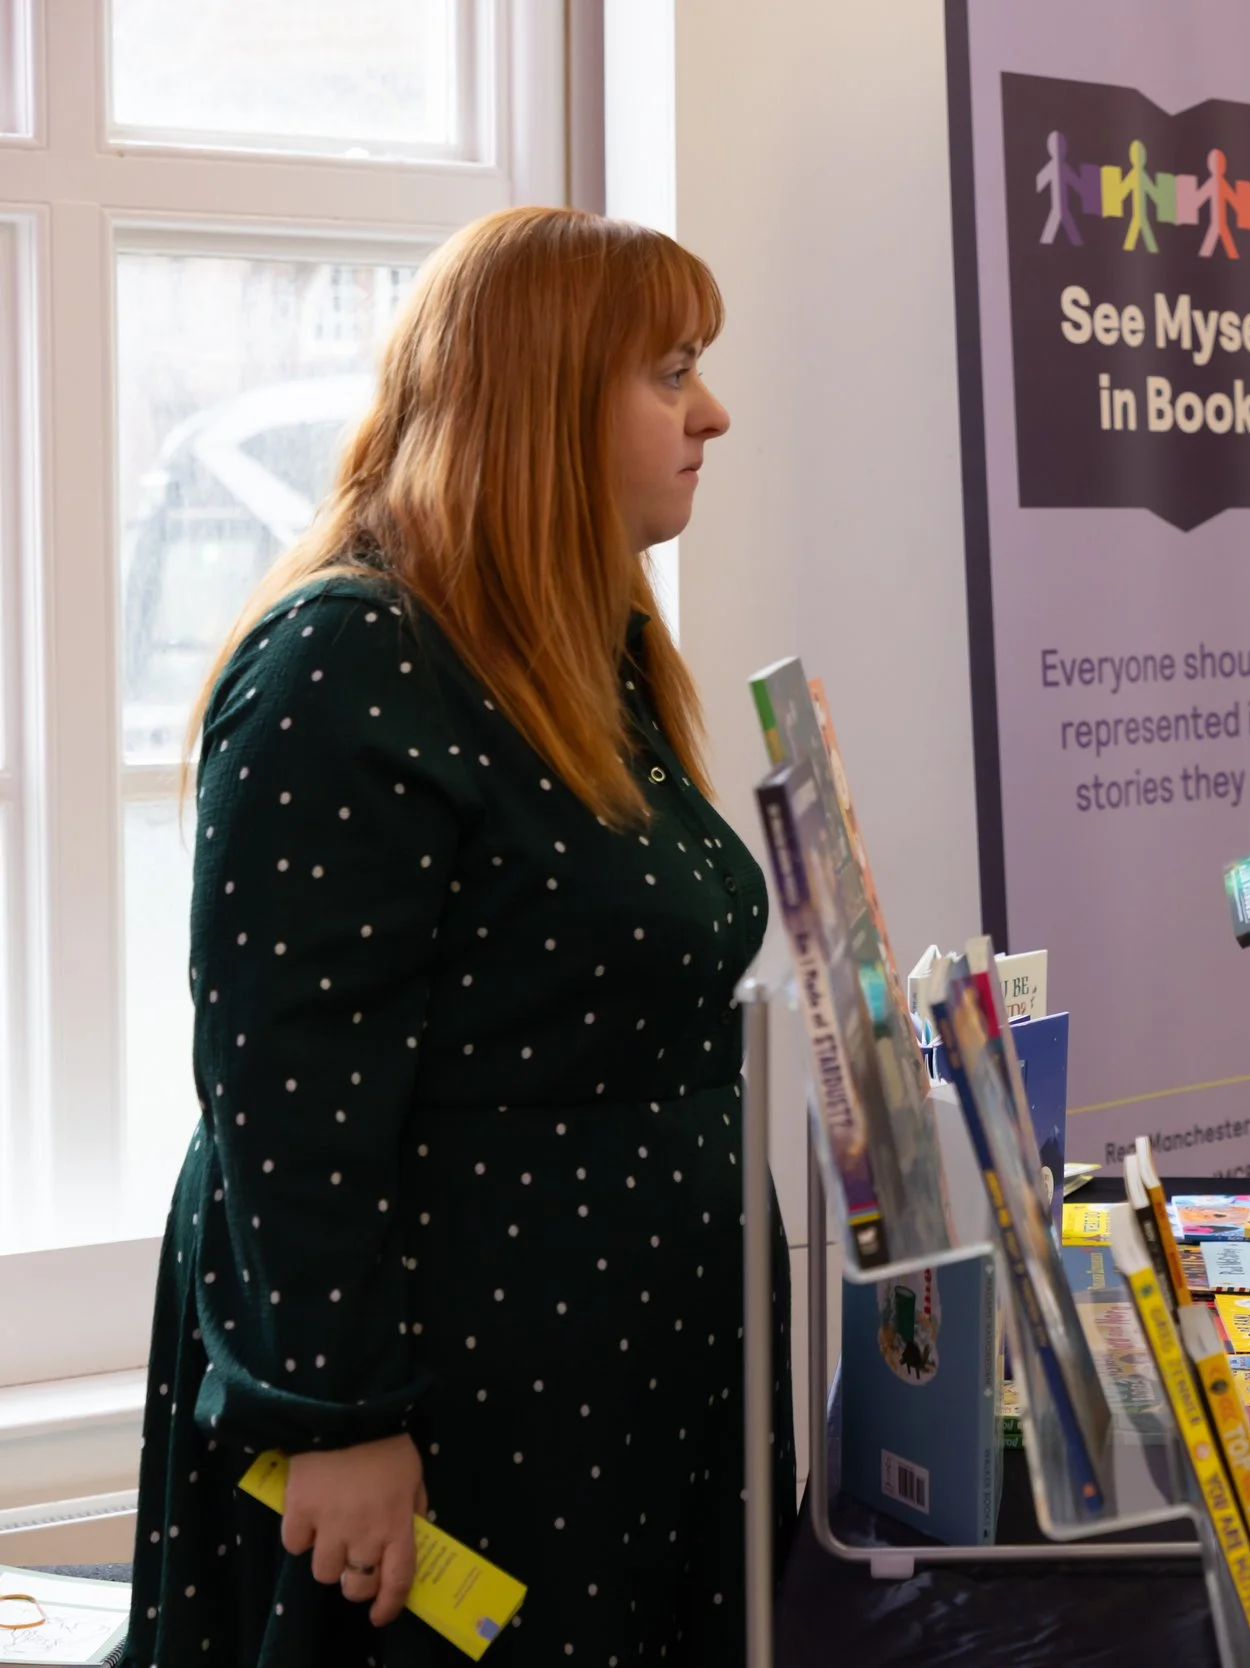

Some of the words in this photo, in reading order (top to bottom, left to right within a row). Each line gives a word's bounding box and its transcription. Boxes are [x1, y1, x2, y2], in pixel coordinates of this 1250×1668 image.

[1061, 284, 1145, 347] See
[1098, 373, 1137, 430] in
[1040, 648, 1175, 693] Everyone
[1061, 702, 1241, 757] represented
[1076, 769, 1173, 812] stories
[1181, 764, 1245, 807] they
[1013, 976, 1030, 997] BE
[1148, 1306, 1174, 1355] GREG
[1203, 1471, 1231, 1510] YOU
[1213, 1511, 1243, 1553] ARE
